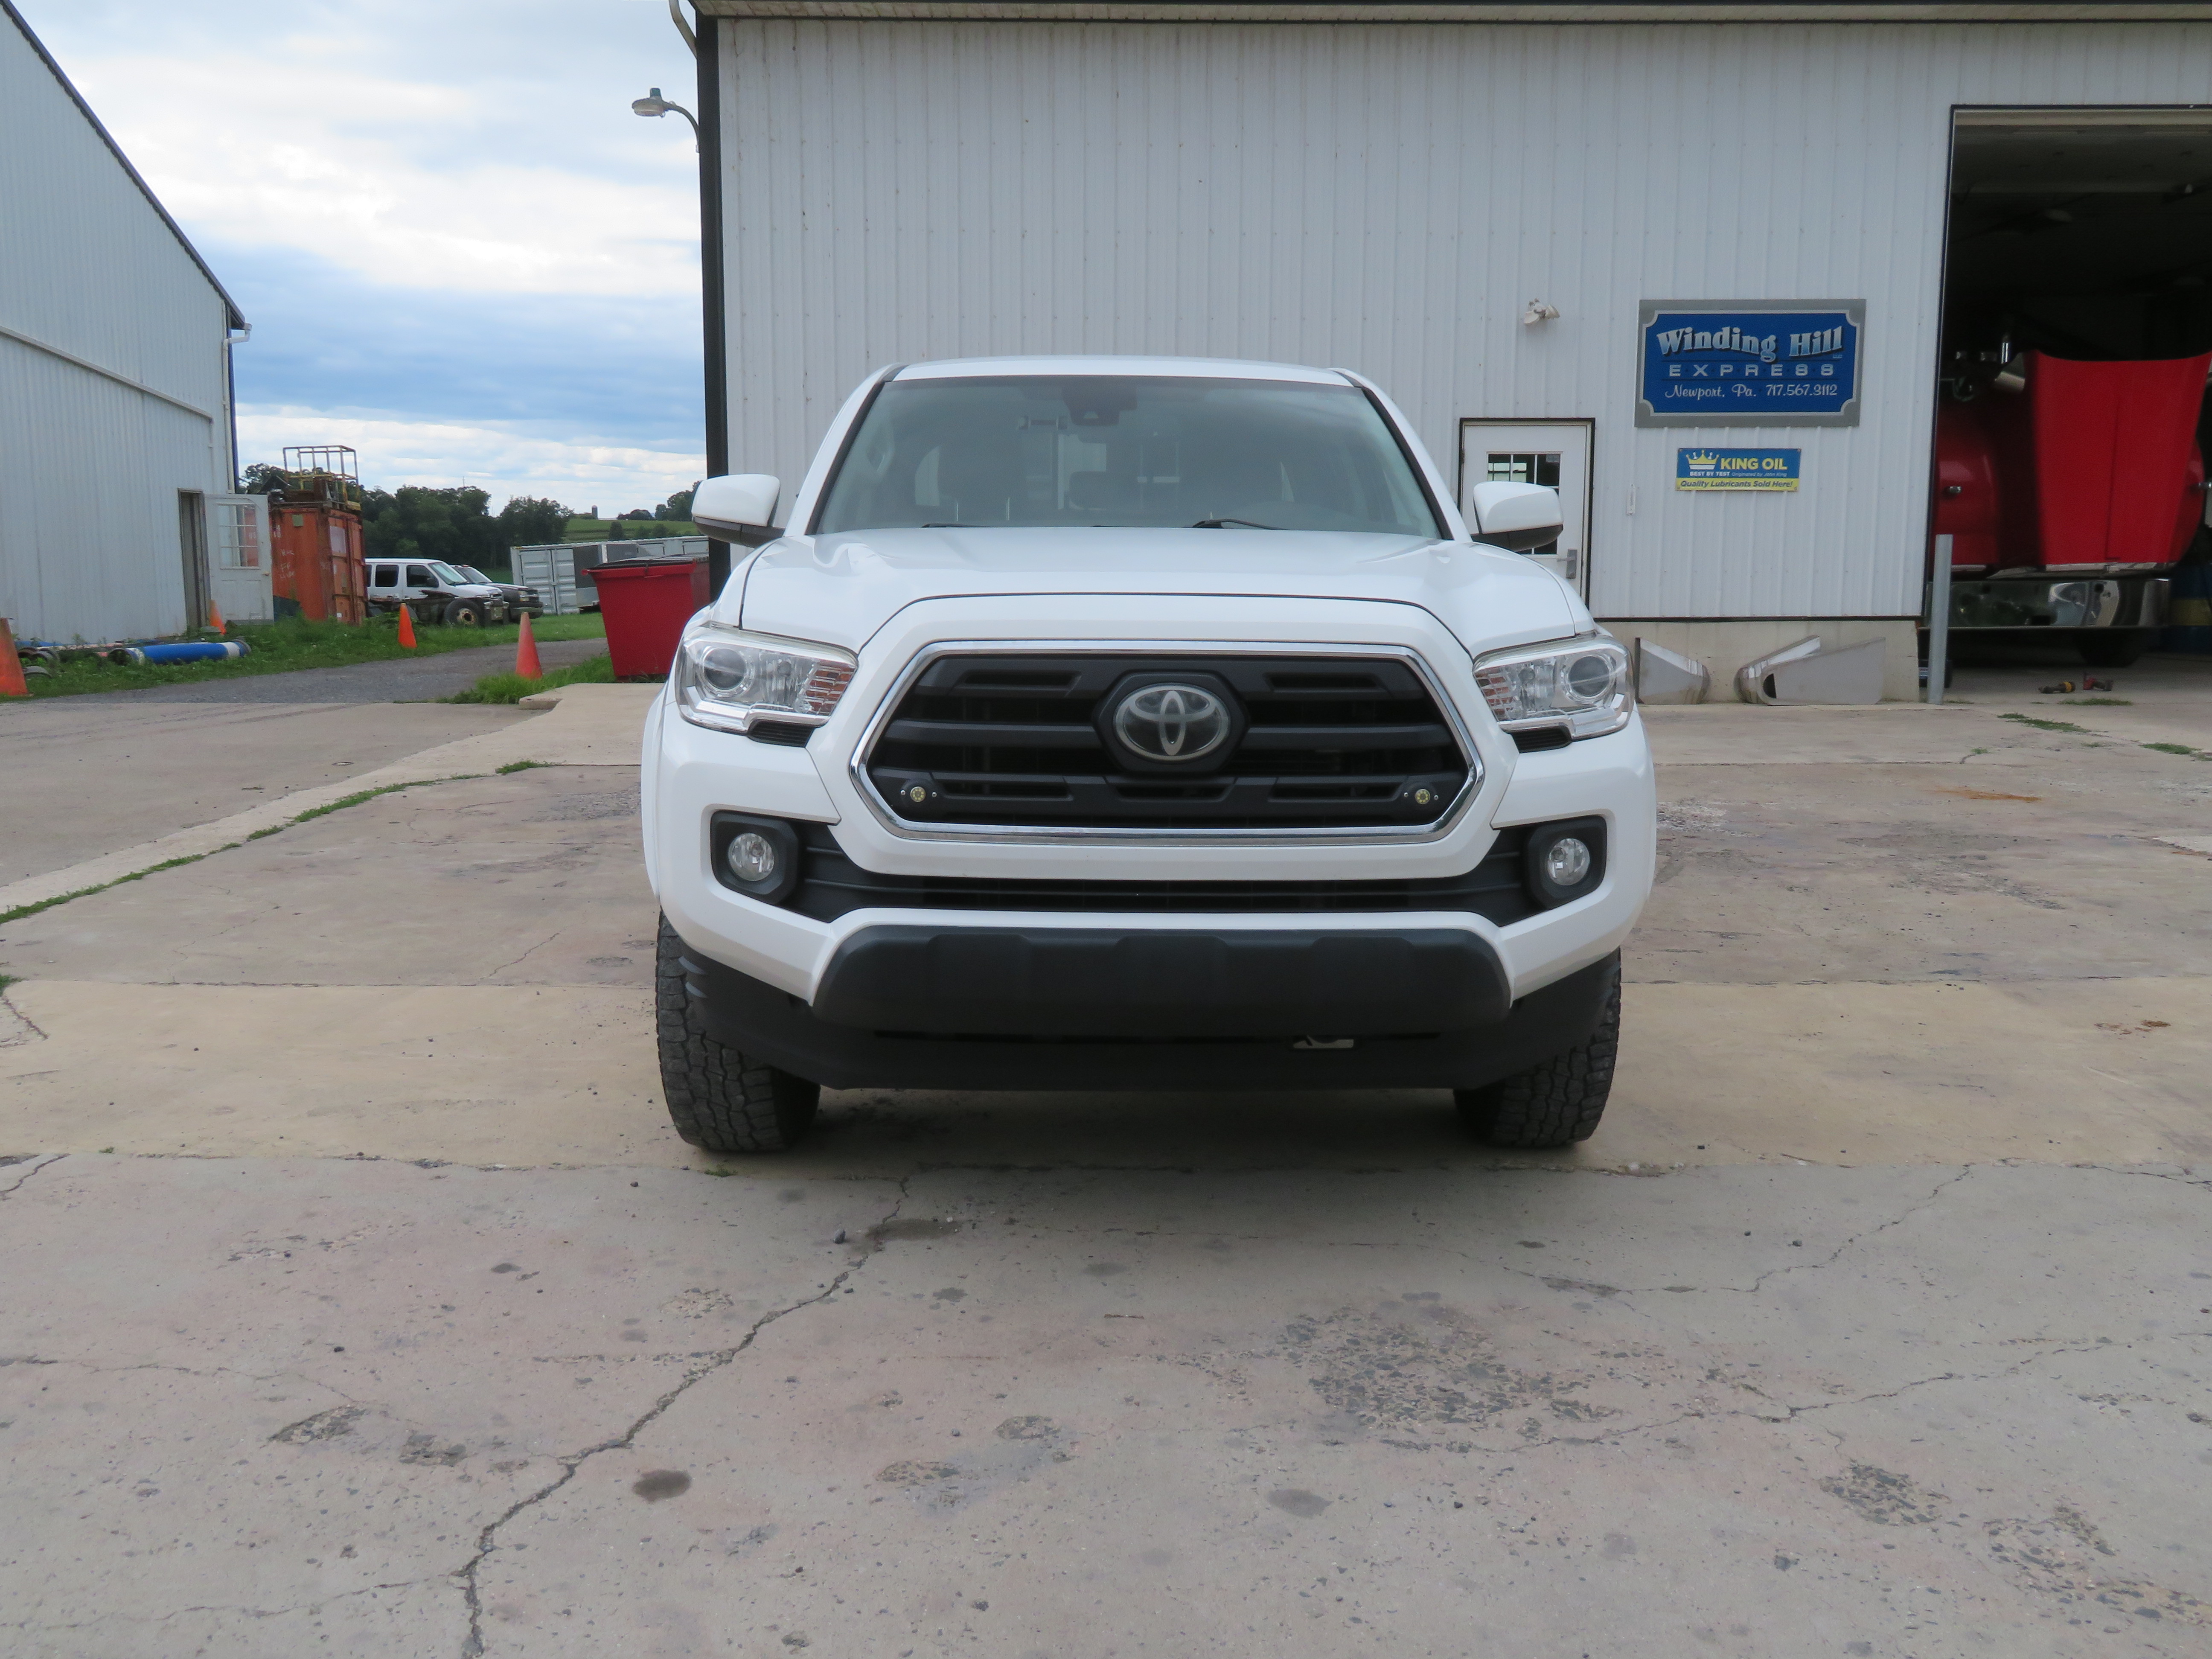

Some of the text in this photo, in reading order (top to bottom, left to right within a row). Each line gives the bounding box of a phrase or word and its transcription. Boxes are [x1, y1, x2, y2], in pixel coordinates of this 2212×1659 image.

[1656, 326, 1842, 363] Winding Hill
[1731, 384, 1757, 397] Pa.
[1765, 384, 1838, 396] 717.567.3112
[1720, 458, 1787, 470] KING OIL
[1680, 480, 1708, 488] Quality
